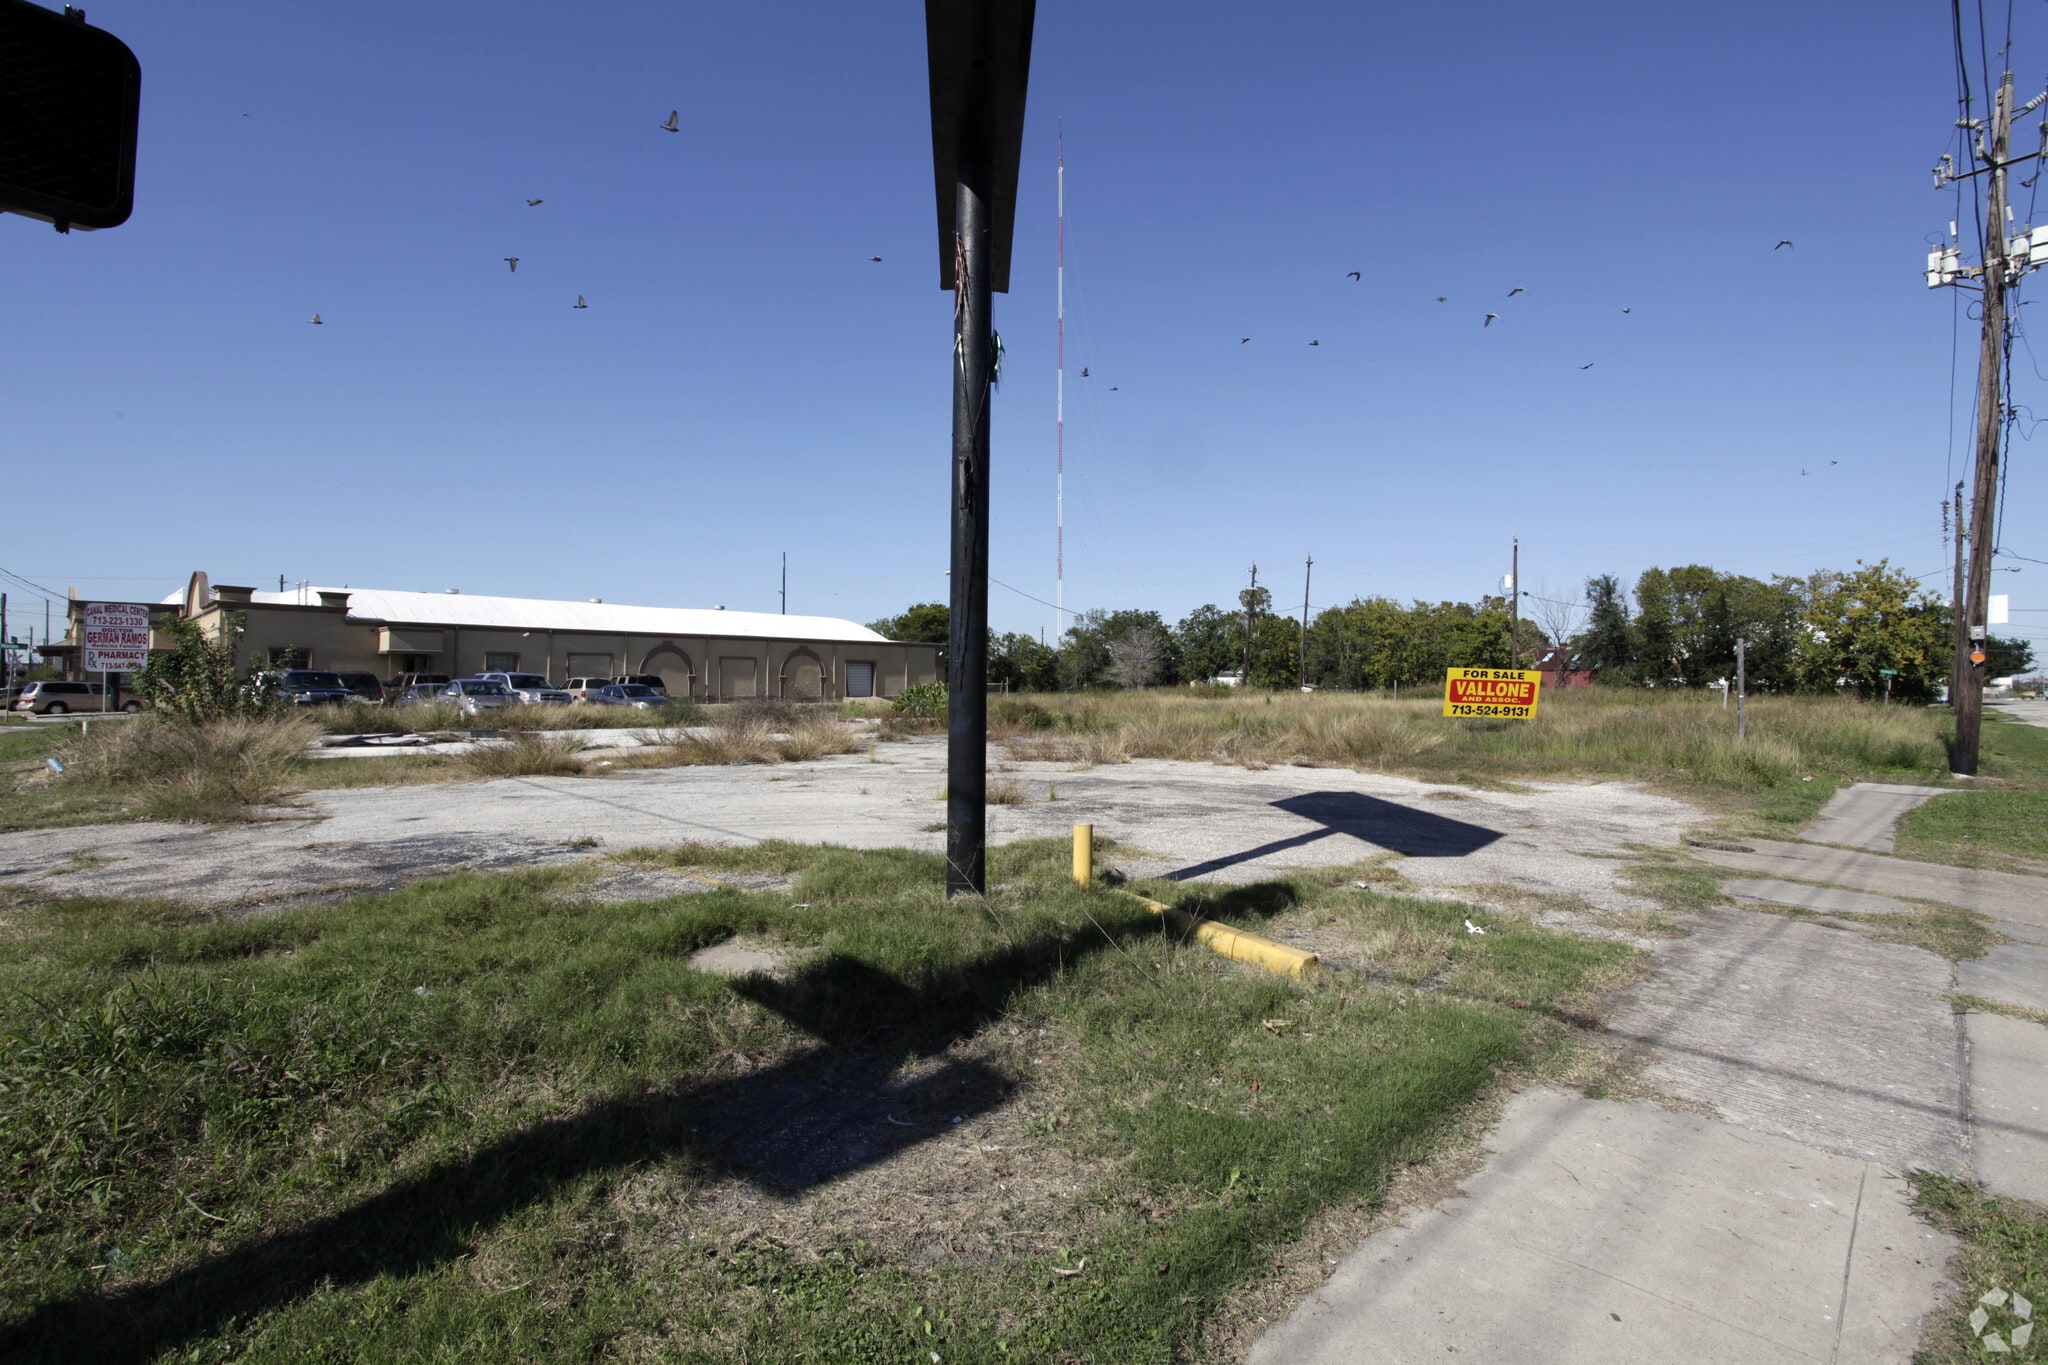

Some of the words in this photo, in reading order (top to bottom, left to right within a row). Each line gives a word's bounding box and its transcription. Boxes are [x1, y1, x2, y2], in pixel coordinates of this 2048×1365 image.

[104, 605, 128, 614] MEDICAL
[93, 616, 143, 625] 713-223-1330
[87, 632, 119, 644] GERMAN
[121, 633, 147, 645] RAMOS
[98, 651, 145, 659] PHARMACY
[1463, 670, 1488, 679] FOR
[1493, 671, 1525, 680] SALE
[1456, 681, 1530, 697] VALLONE
[1452, 705, 1529, 717] 713-524-9131
